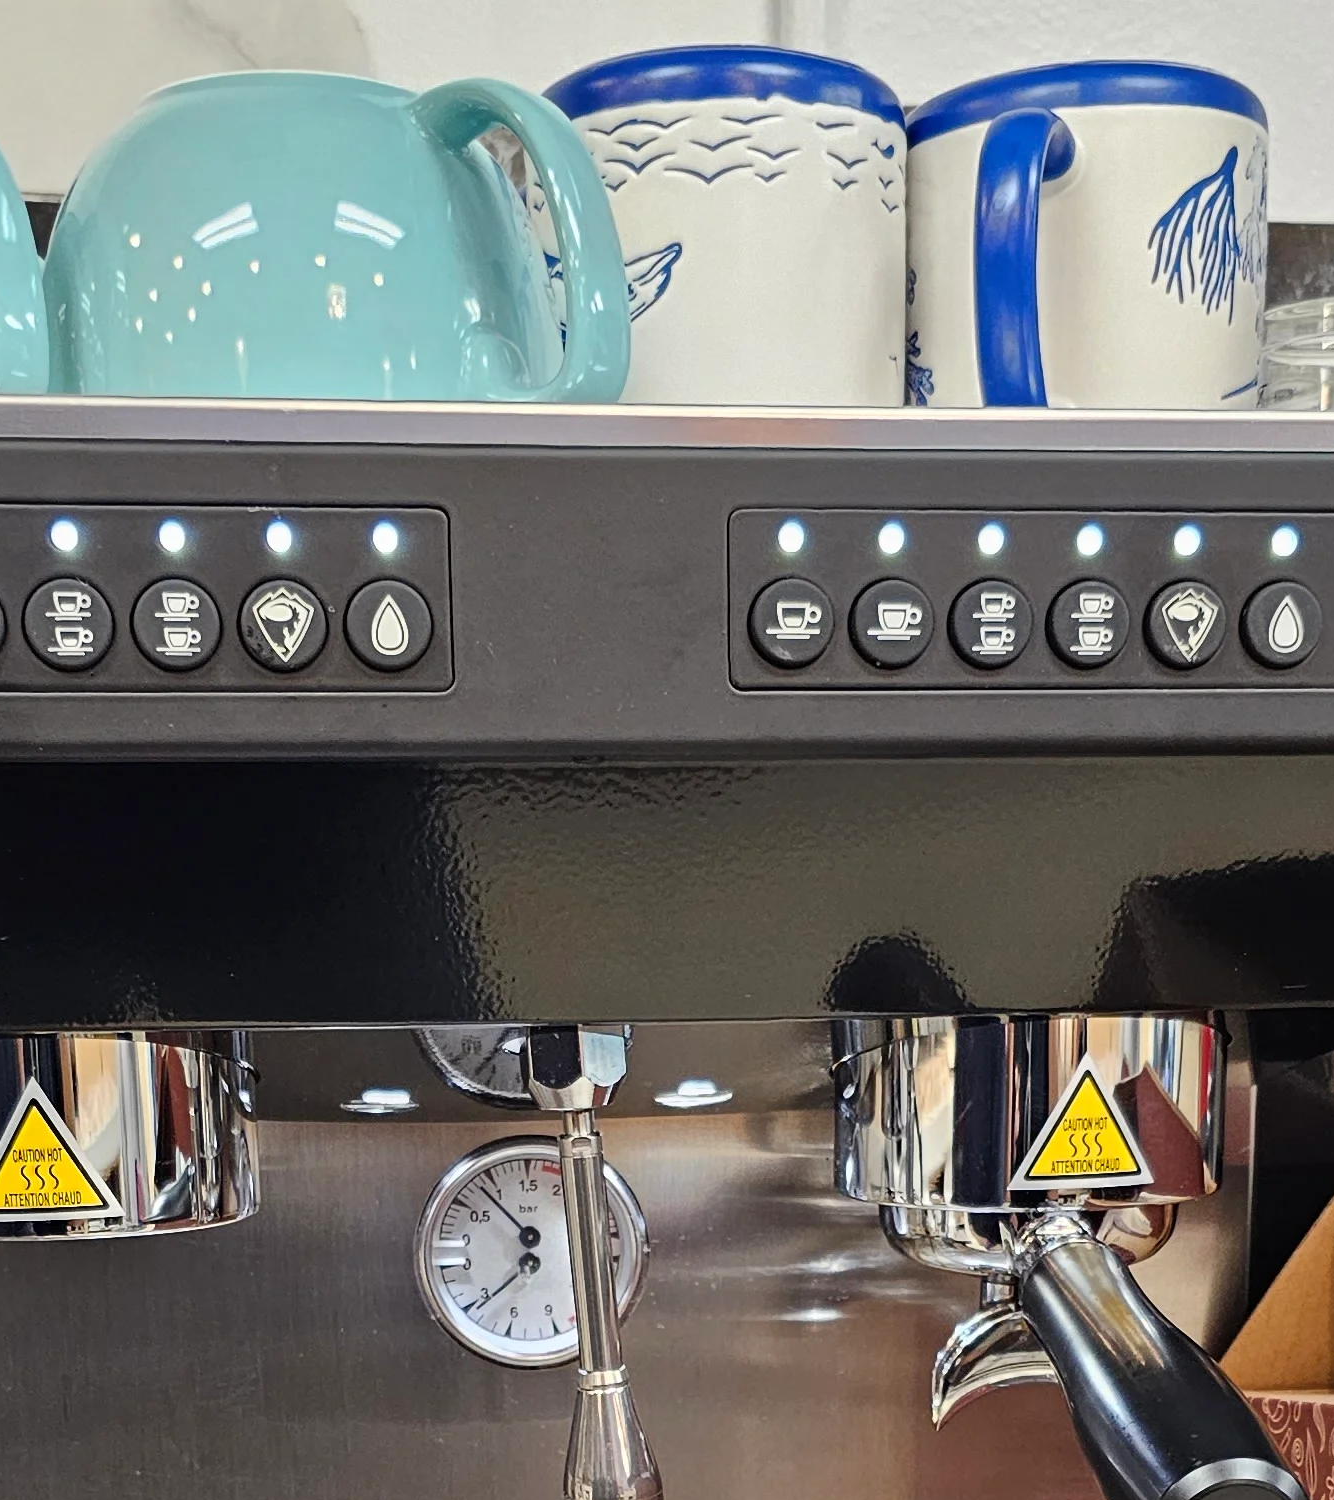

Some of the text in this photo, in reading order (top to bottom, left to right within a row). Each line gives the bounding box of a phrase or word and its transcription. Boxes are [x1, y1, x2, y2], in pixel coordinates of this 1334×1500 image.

[1062, 1116, 1108, 1132] CAUTION HOT
[12, 1147, 63, 1163] CAUTION HOT
[1051, 1157, 1121, 1174] ATTENTION CHAUD
[518, 1179, 538, 1194] 1,5
[552, 1184, 562, 1197] 2
[3, 1190, 82, 1208] ATTENTION CHAUD
[496, 1189, 503, 1201] 1
[519, 1203, 538, 1214] bar
[469, 1210, 491, 1223] 0,5
[480, 1287, 491, 1300] 3
[510, 1306, 519, 1319] 6
[544, 1304, 553, 1317] 9
